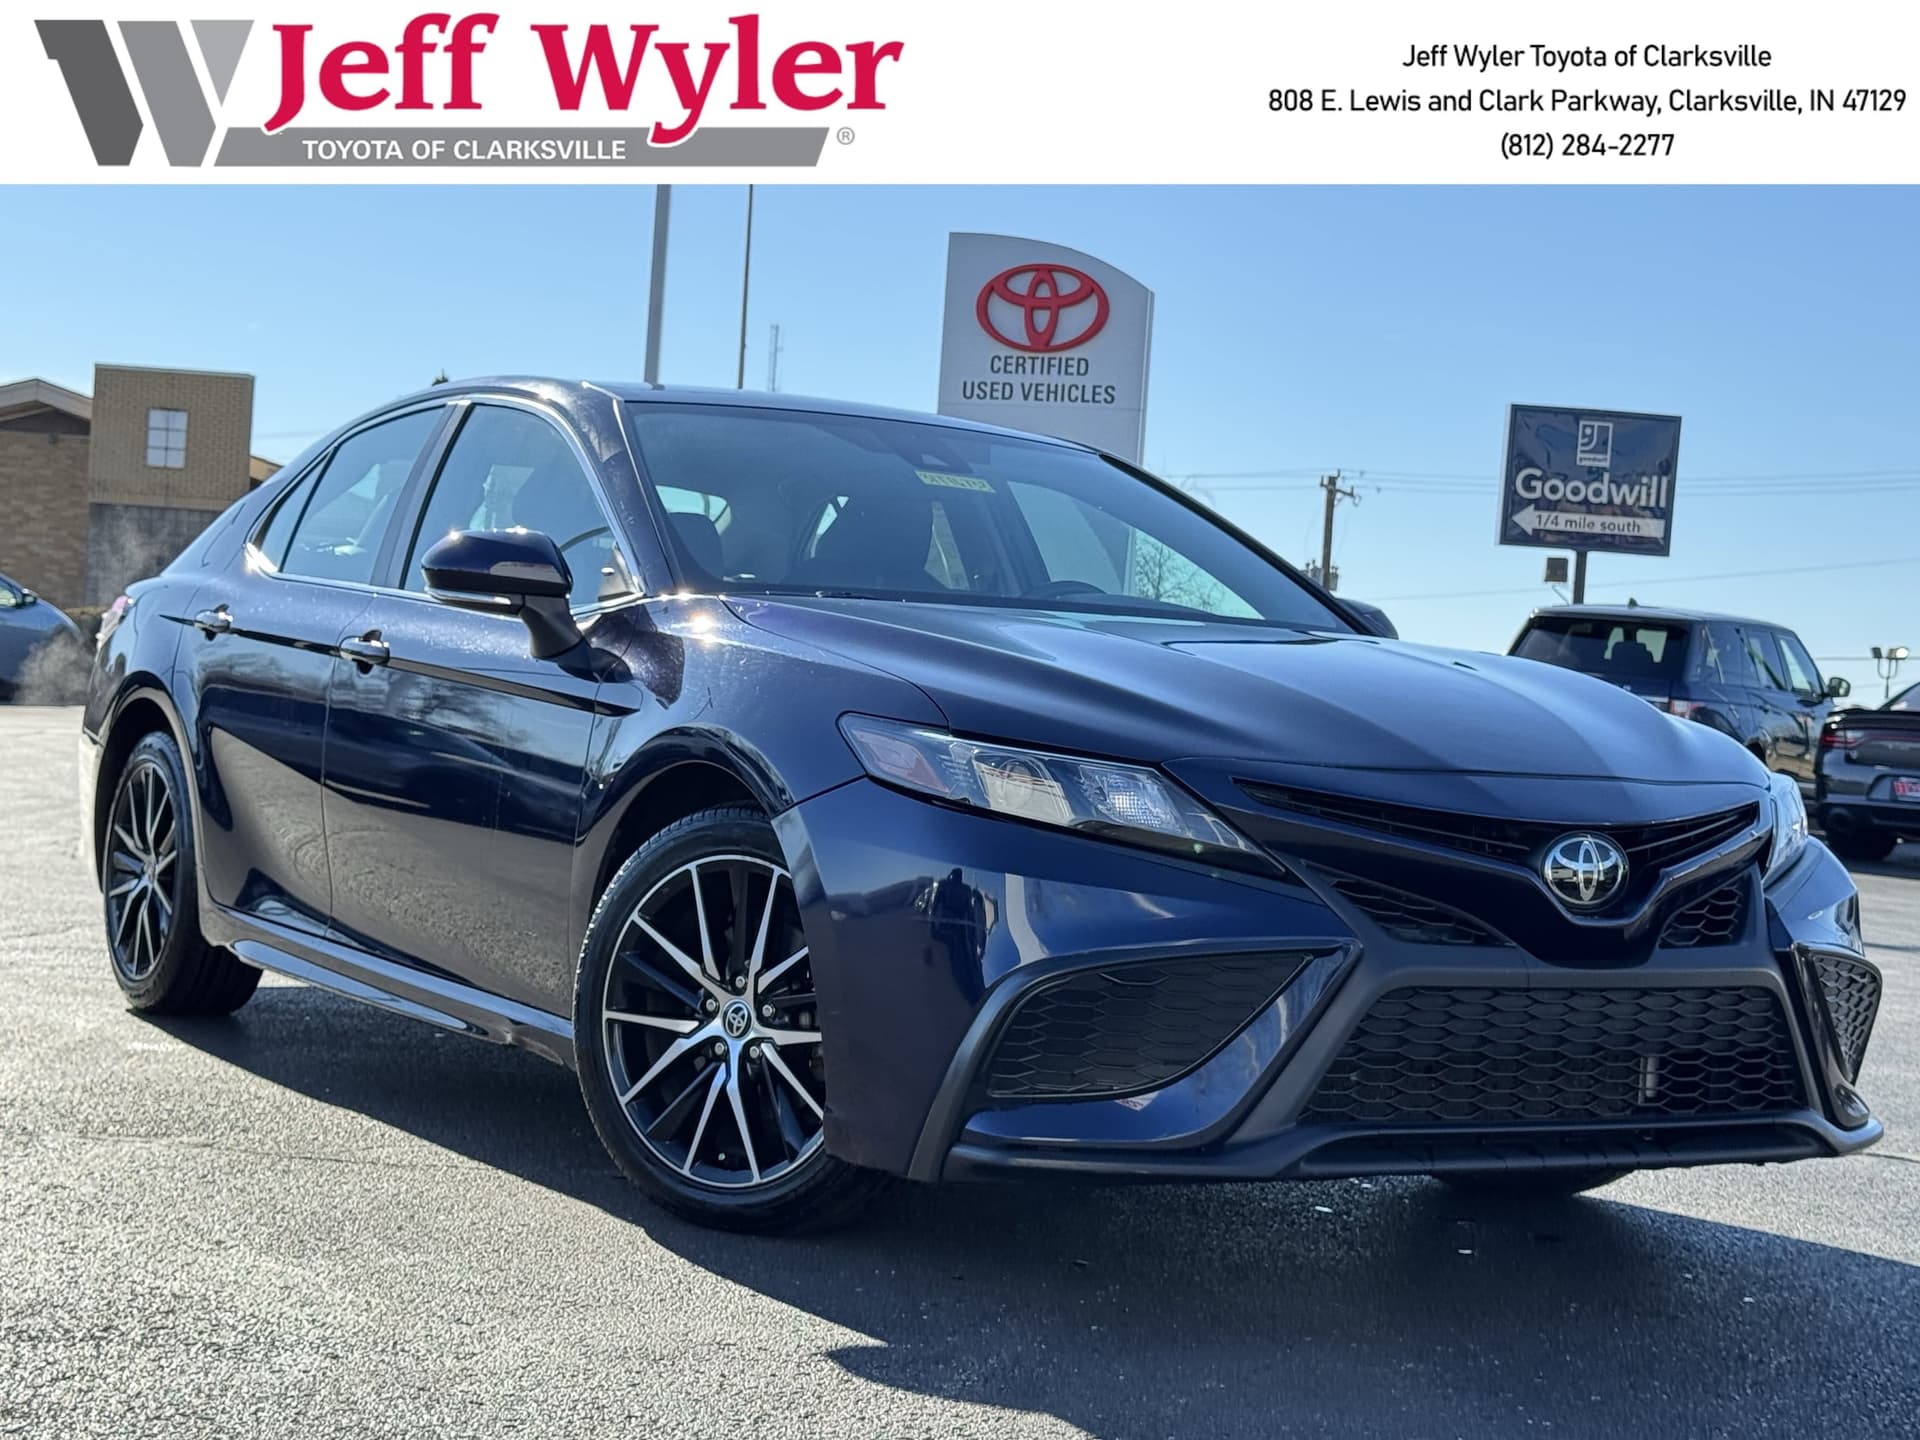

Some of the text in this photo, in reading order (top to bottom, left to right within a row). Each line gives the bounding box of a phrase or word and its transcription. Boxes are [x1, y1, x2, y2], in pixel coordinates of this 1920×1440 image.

[990, 354, 1089, 377] CERTIFIED
[962, 380, 1116, 405] USED VEHICLES
[1515, 467, 1668, 508] Goodwill
[1536, 513, 1641, 534] 1/4 mile south
